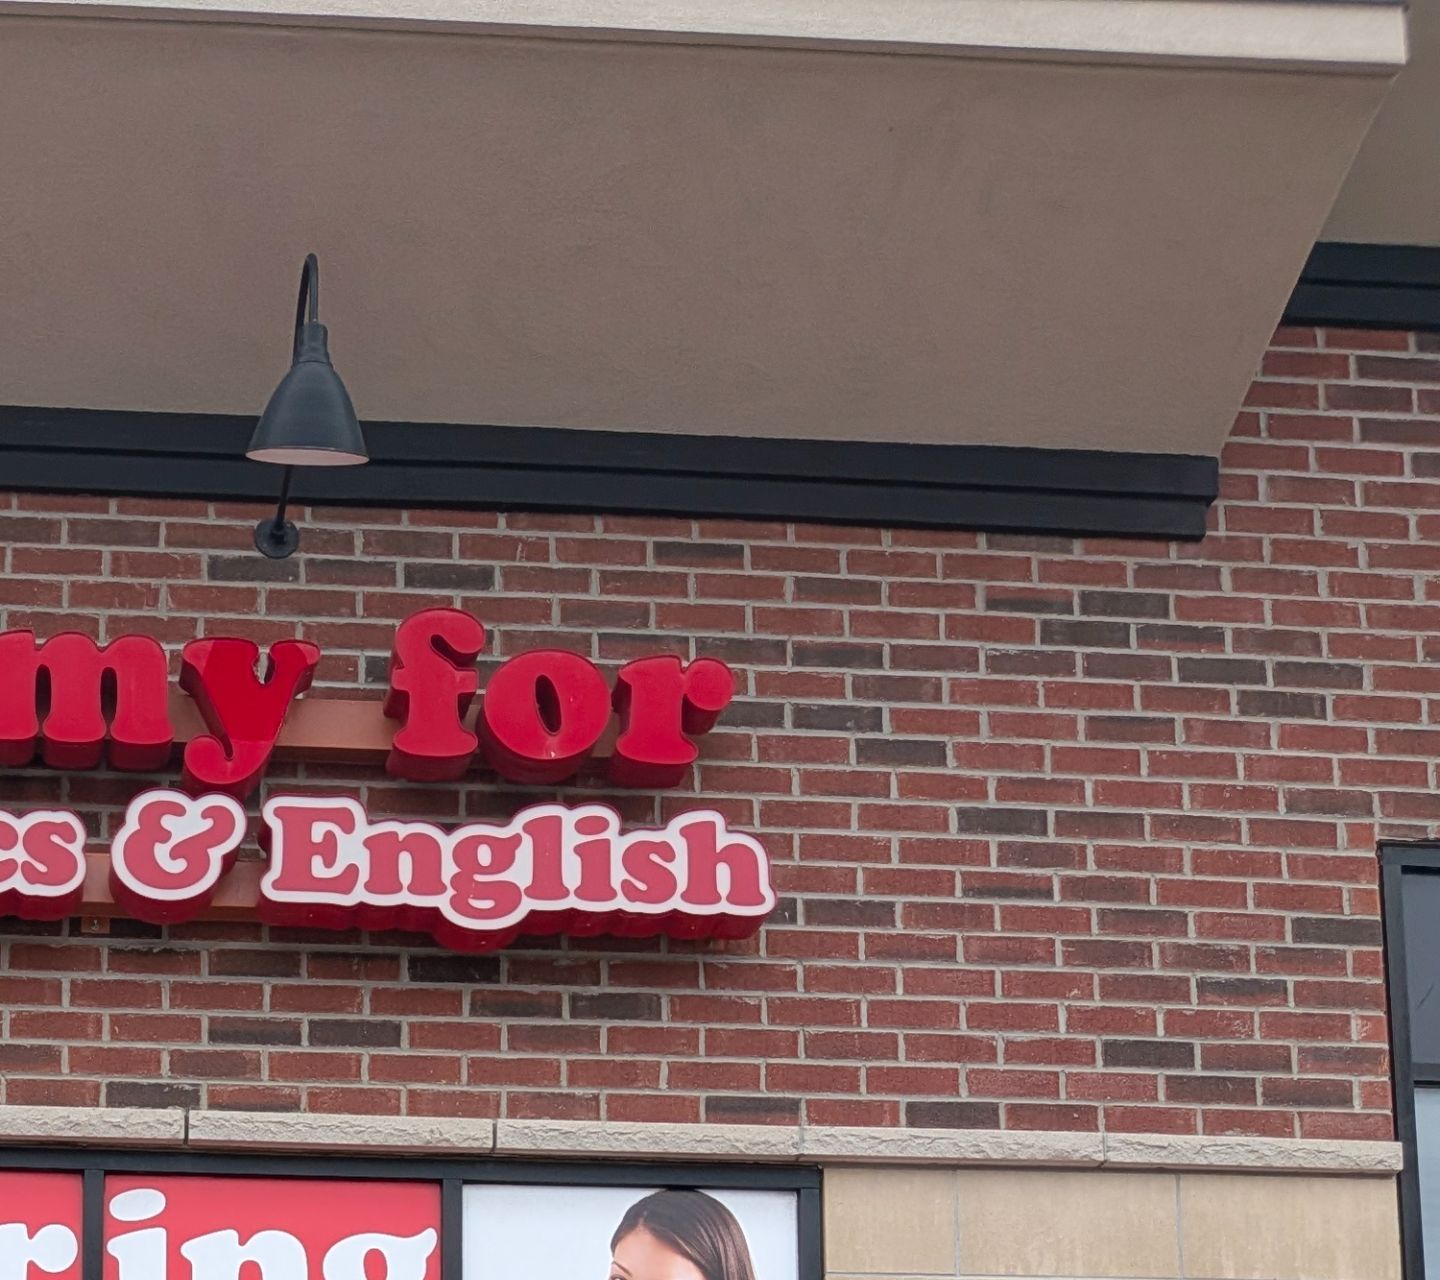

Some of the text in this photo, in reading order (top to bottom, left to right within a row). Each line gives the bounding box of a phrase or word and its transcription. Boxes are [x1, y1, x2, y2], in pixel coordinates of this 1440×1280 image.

[385, 606, 735, 788] for
[110, 787, 249, 903] &
[260, 794, 776, 931] English
